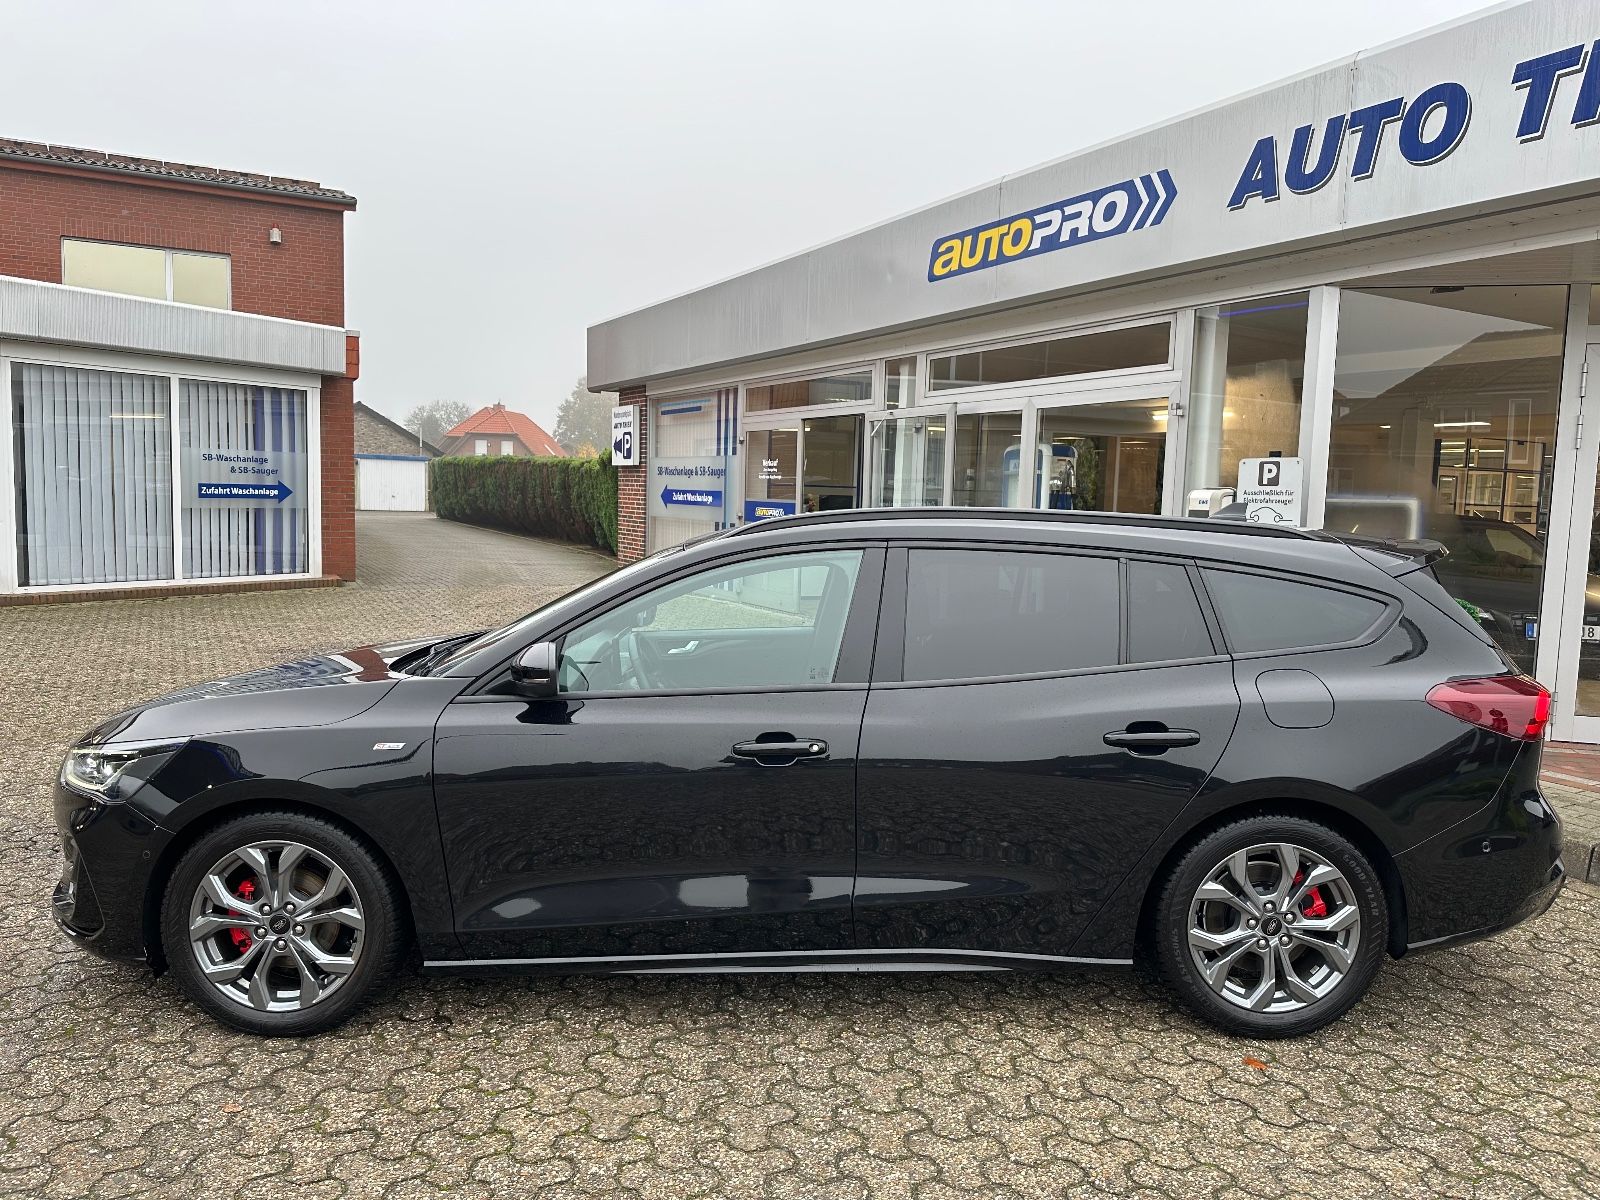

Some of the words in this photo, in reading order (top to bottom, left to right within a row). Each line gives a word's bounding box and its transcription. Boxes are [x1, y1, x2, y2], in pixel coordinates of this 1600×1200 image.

[1226, 82, 1472, 212] AUTO
[202, 453, 269, 465] SB-Waschanlage
[230, 465, 237, 474] &
[238, 466, 279, 476] SB-Sauger
[657, 466, 694, 478] SB-Waschanlage
[201, 486, 230, 495] Zufahrt
[230, 487, 279, 497] Waschanlage
